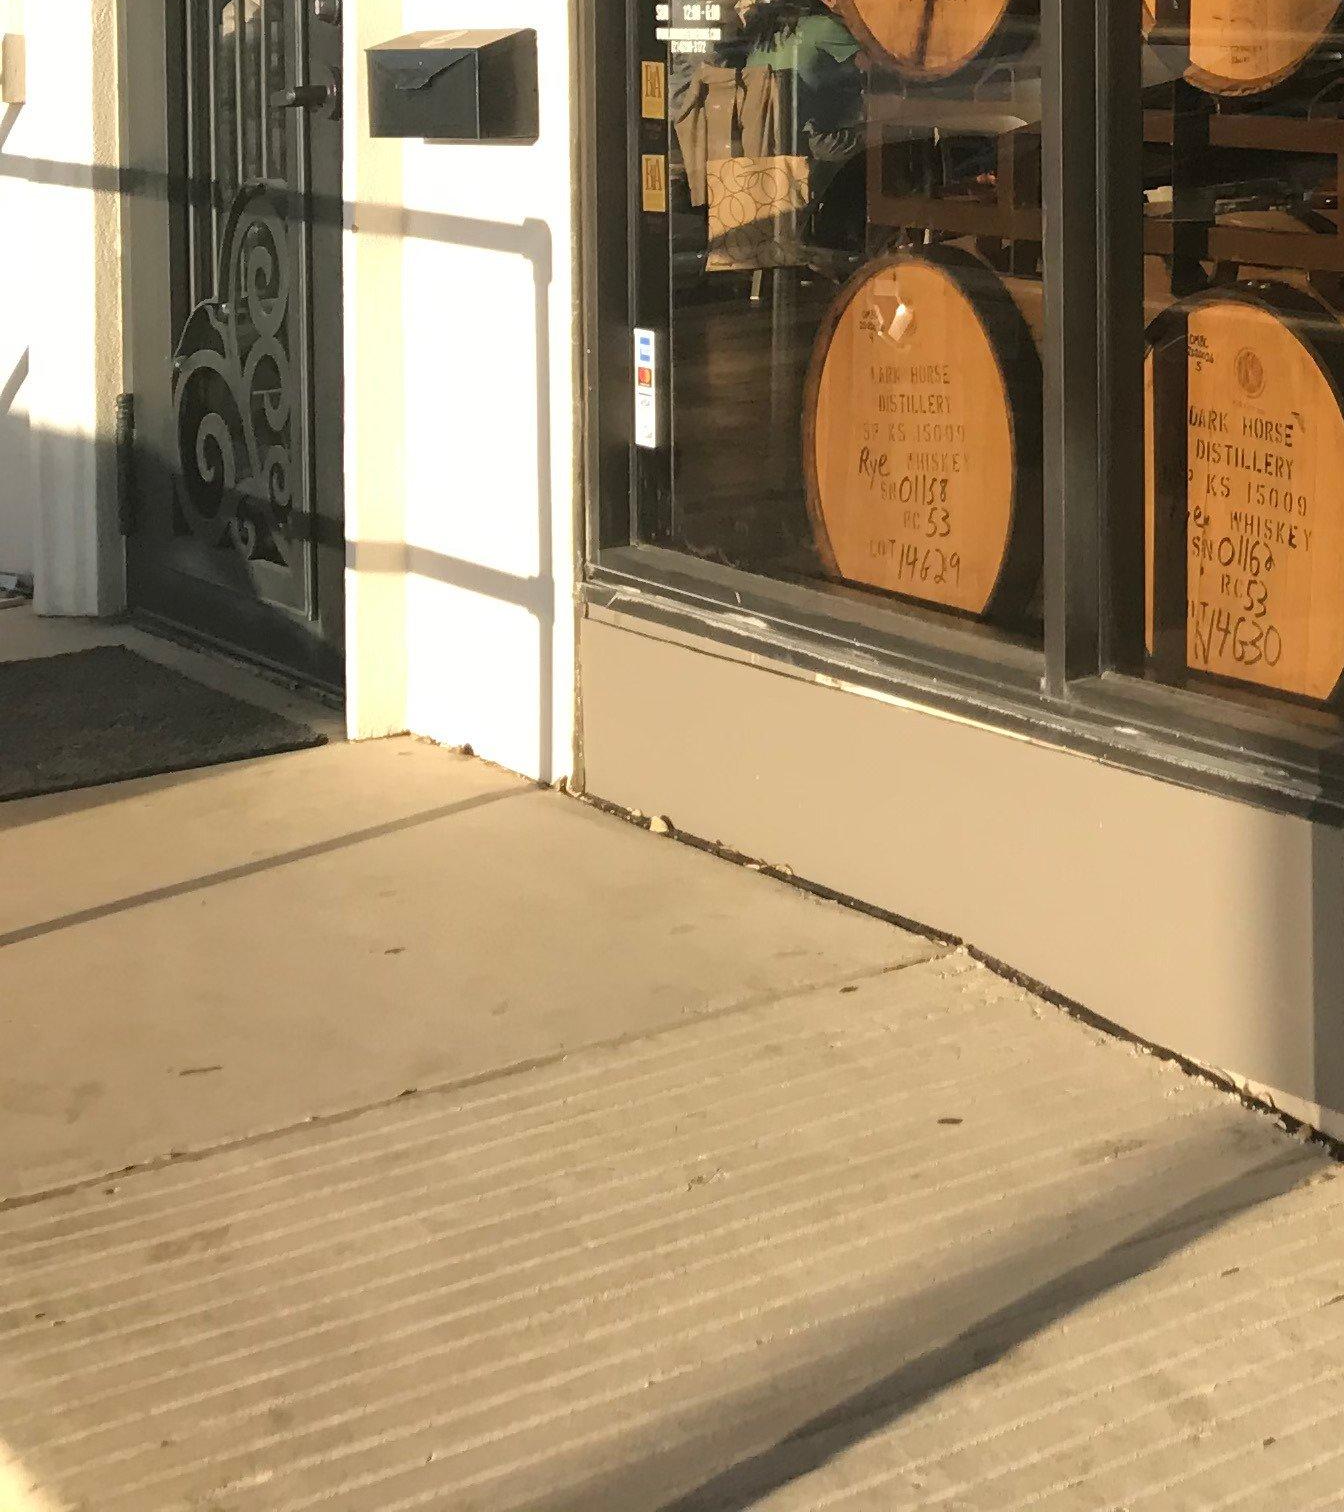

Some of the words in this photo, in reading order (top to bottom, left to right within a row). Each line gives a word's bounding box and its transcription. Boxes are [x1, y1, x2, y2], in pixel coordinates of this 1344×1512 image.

[879, 394, 951, 414] DISTILLERY
[1189, 405, 1229, 433] DARK
[1242, 416, 1294, 448] HORSE
[859, 446, 890, 490] Rye
[1196, 438, 1294, 479] DISTILLERY
[899, 474, 948, 505] 01158
[1206, 473, 1230, 497] KS
[1247, 482, 1307, 517] 15009
[926, 507, 951, 537] 53
[1231, 511, 1312, 552] WHISKEY
[1192, 536, 1213, 561] SN
[1221, 573, 1244, 598] RC
[1243, 579, 1268, 618] 53
